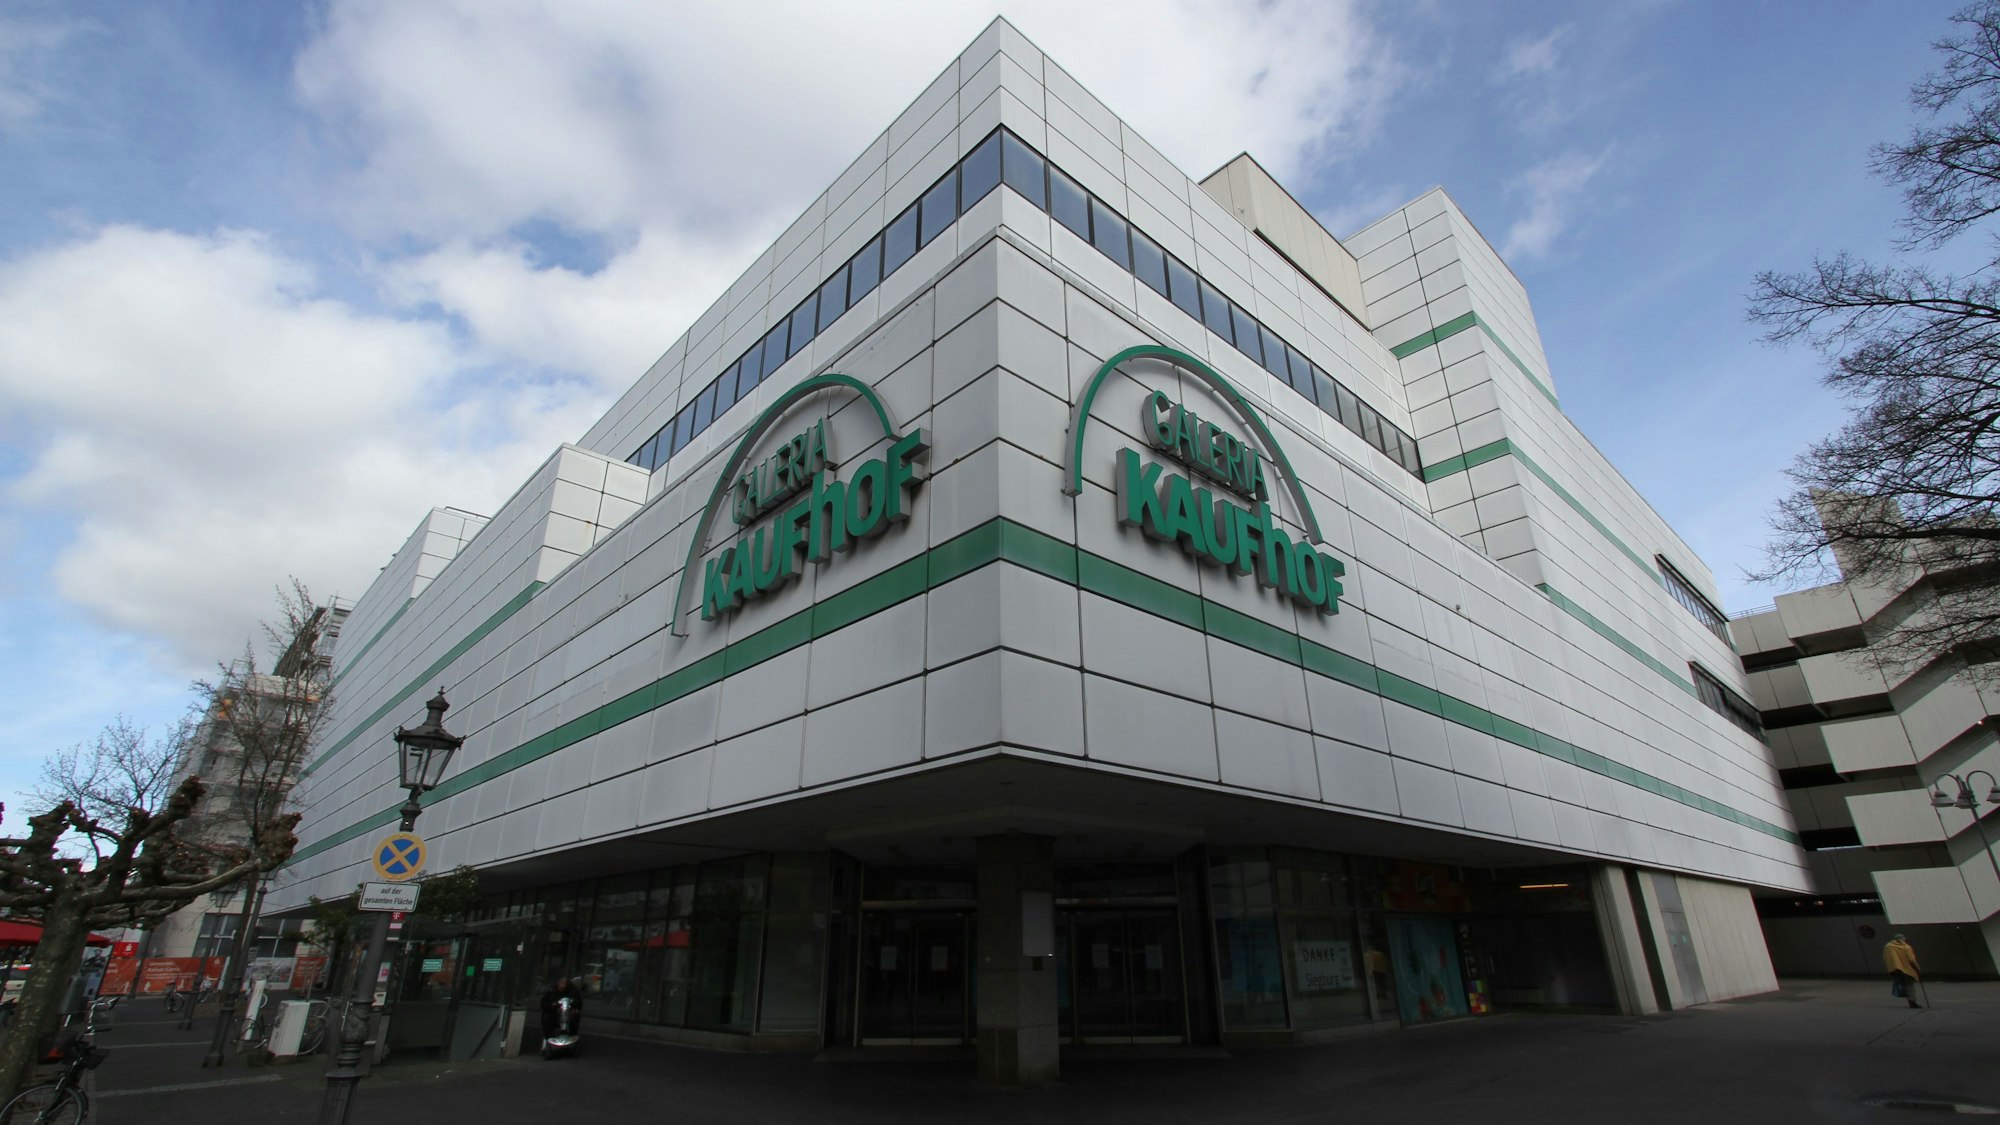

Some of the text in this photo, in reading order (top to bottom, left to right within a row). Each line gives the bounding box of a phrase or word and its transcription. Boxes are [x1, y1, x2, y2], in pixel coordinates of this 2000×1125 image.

[1142, 390, 1269, 501] GALERIA
[732, 417, 837, 525] GALERIA
[380, 886, 402, 895] auf der
[363, 897, 413, 906] gesamten Fläche
[1302, 948, 1335, 962] DANKE
[1305, 972, 1341, 990] Siegburg
